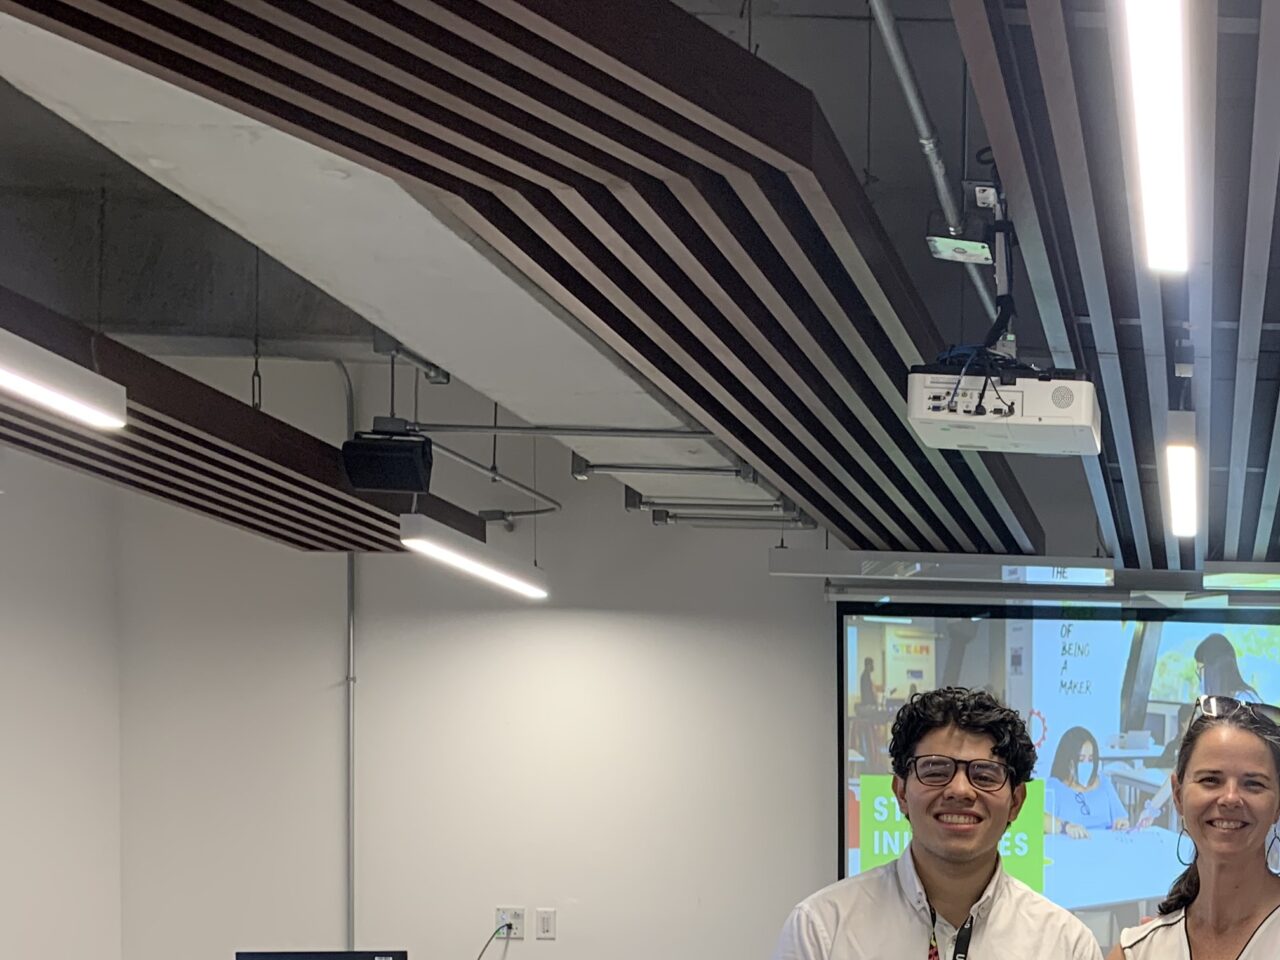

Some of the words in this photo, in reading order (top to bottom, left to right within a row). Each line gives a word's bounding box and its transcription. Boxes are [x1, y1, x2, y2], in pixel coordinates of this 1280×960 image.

[1060, 623, 1073, 638] OF
[1061, 641, 1090, 657] BEING
[1060, 659, 1068, 676] A
[1058, 679, 1092, 696] MAKER
